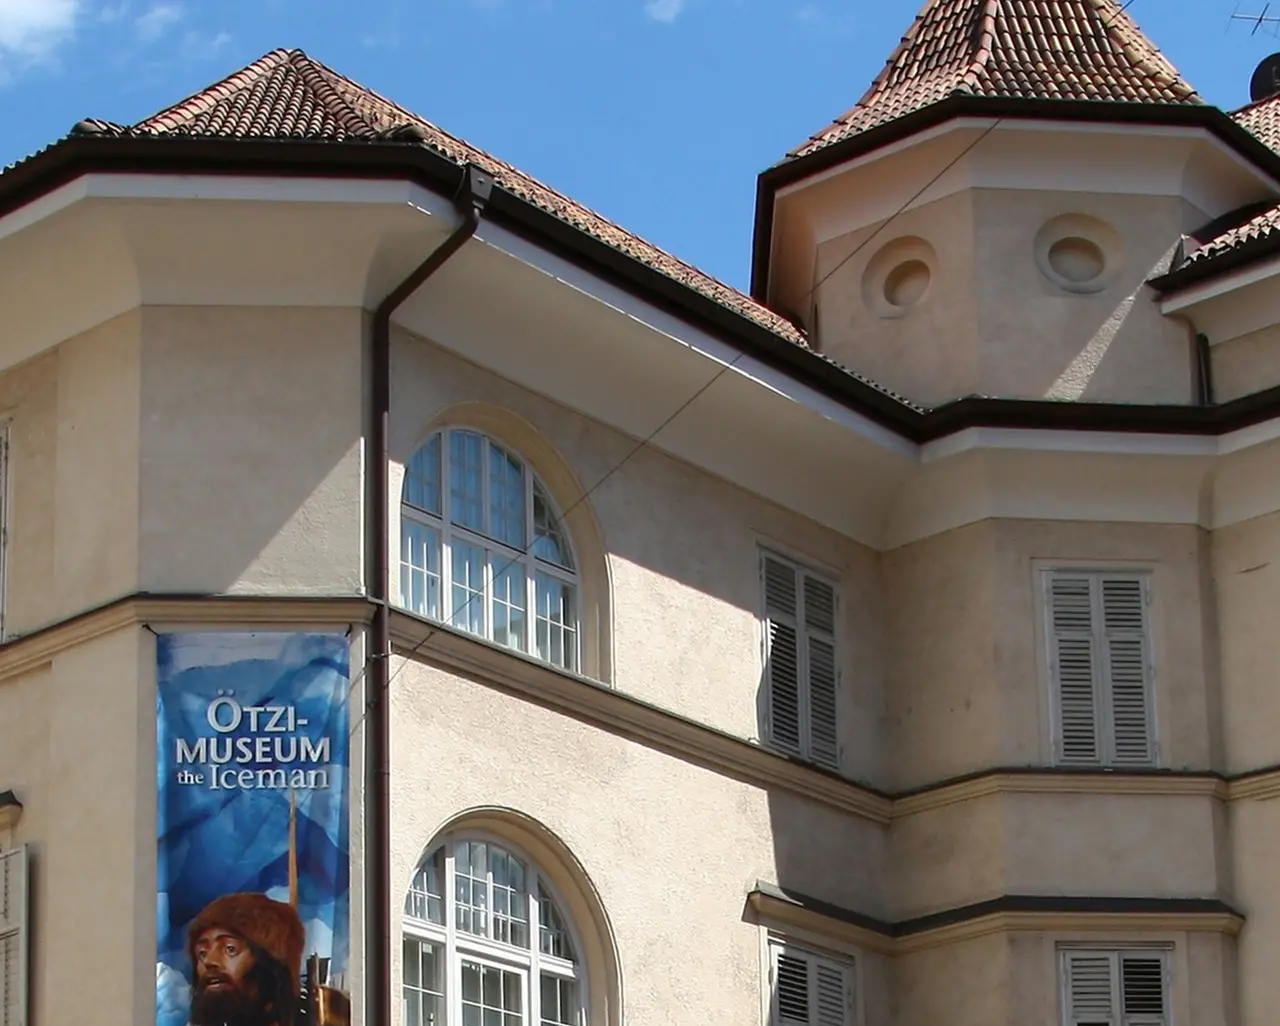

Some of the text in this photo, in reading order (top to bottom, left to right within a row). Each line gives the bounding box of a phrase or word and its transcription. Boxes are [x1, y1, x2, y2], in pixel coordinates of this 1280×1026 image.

[207, 689, 308, 733] ÖTZI-
[176, 737, 330, 764] MUSEUM
[177, 764, 330, 790] the Iceman
